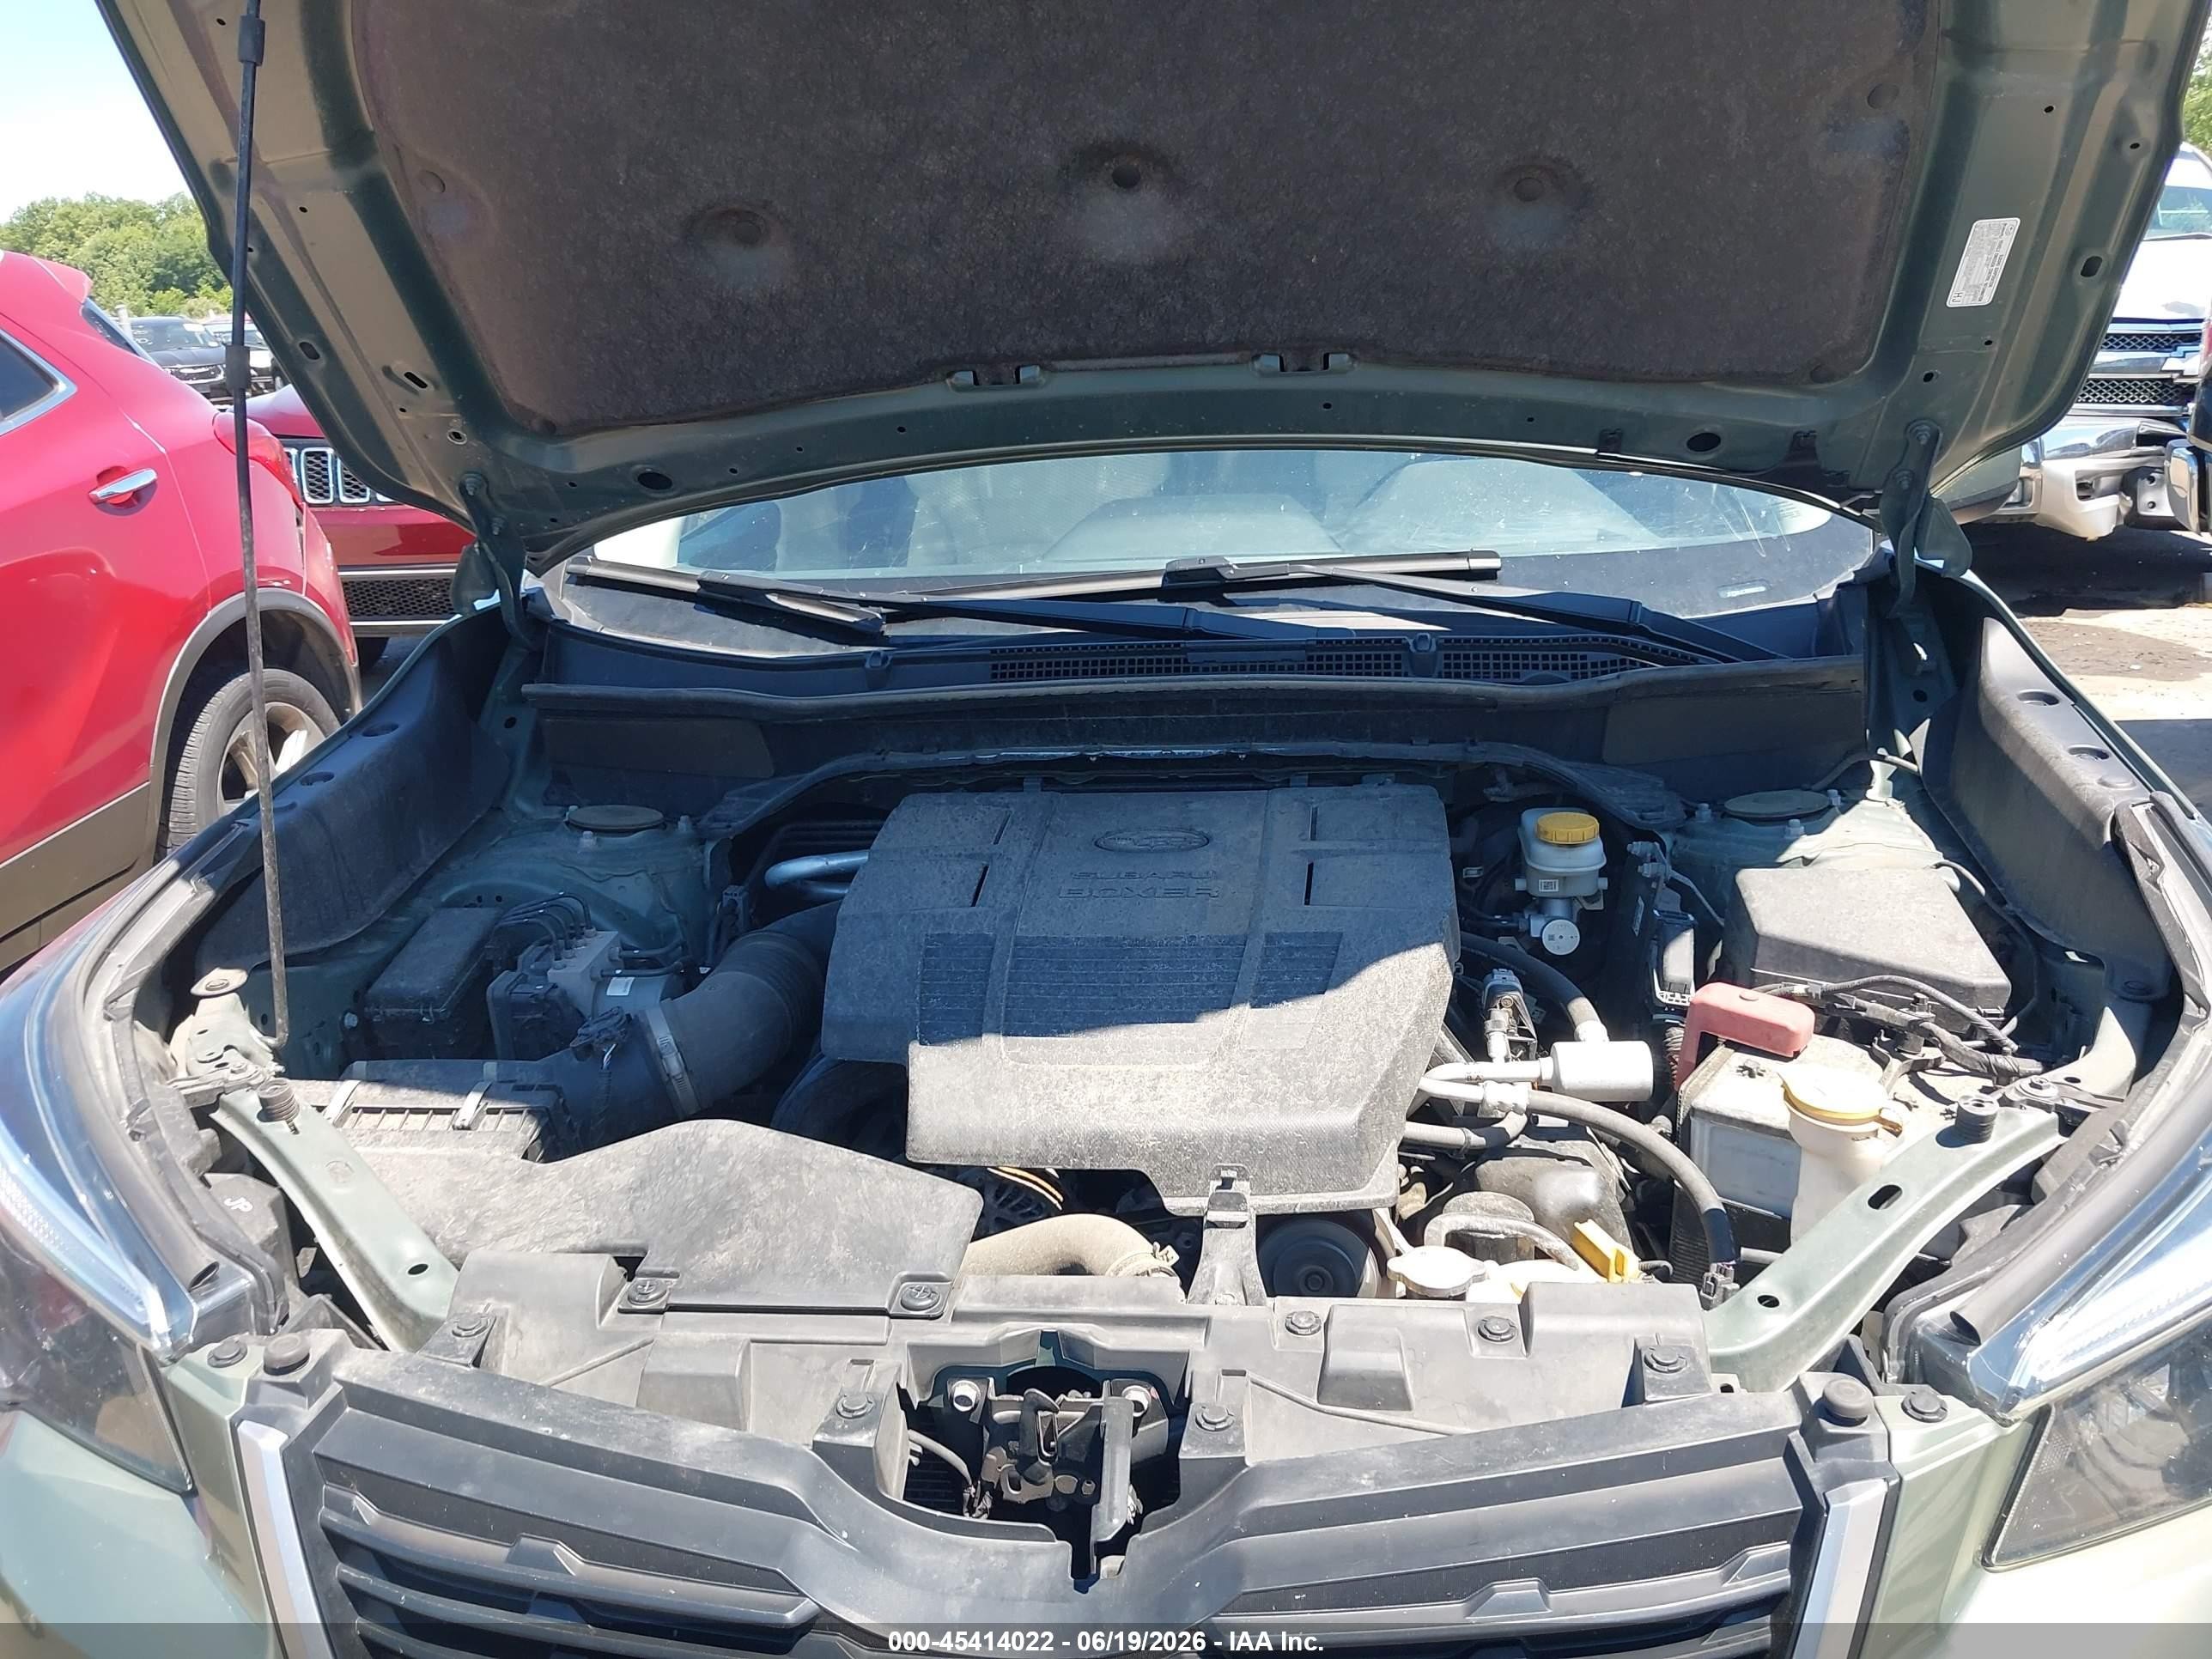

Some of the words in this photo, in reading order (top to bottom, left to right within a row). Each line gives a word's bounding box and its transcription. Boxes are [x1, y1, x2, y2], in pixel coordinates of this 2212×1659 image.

[1071, 870, 1216, 880] SUBARU
[1057, 885, 1220, 899] BOXER
[223, 1197, 253, 1212] JP
